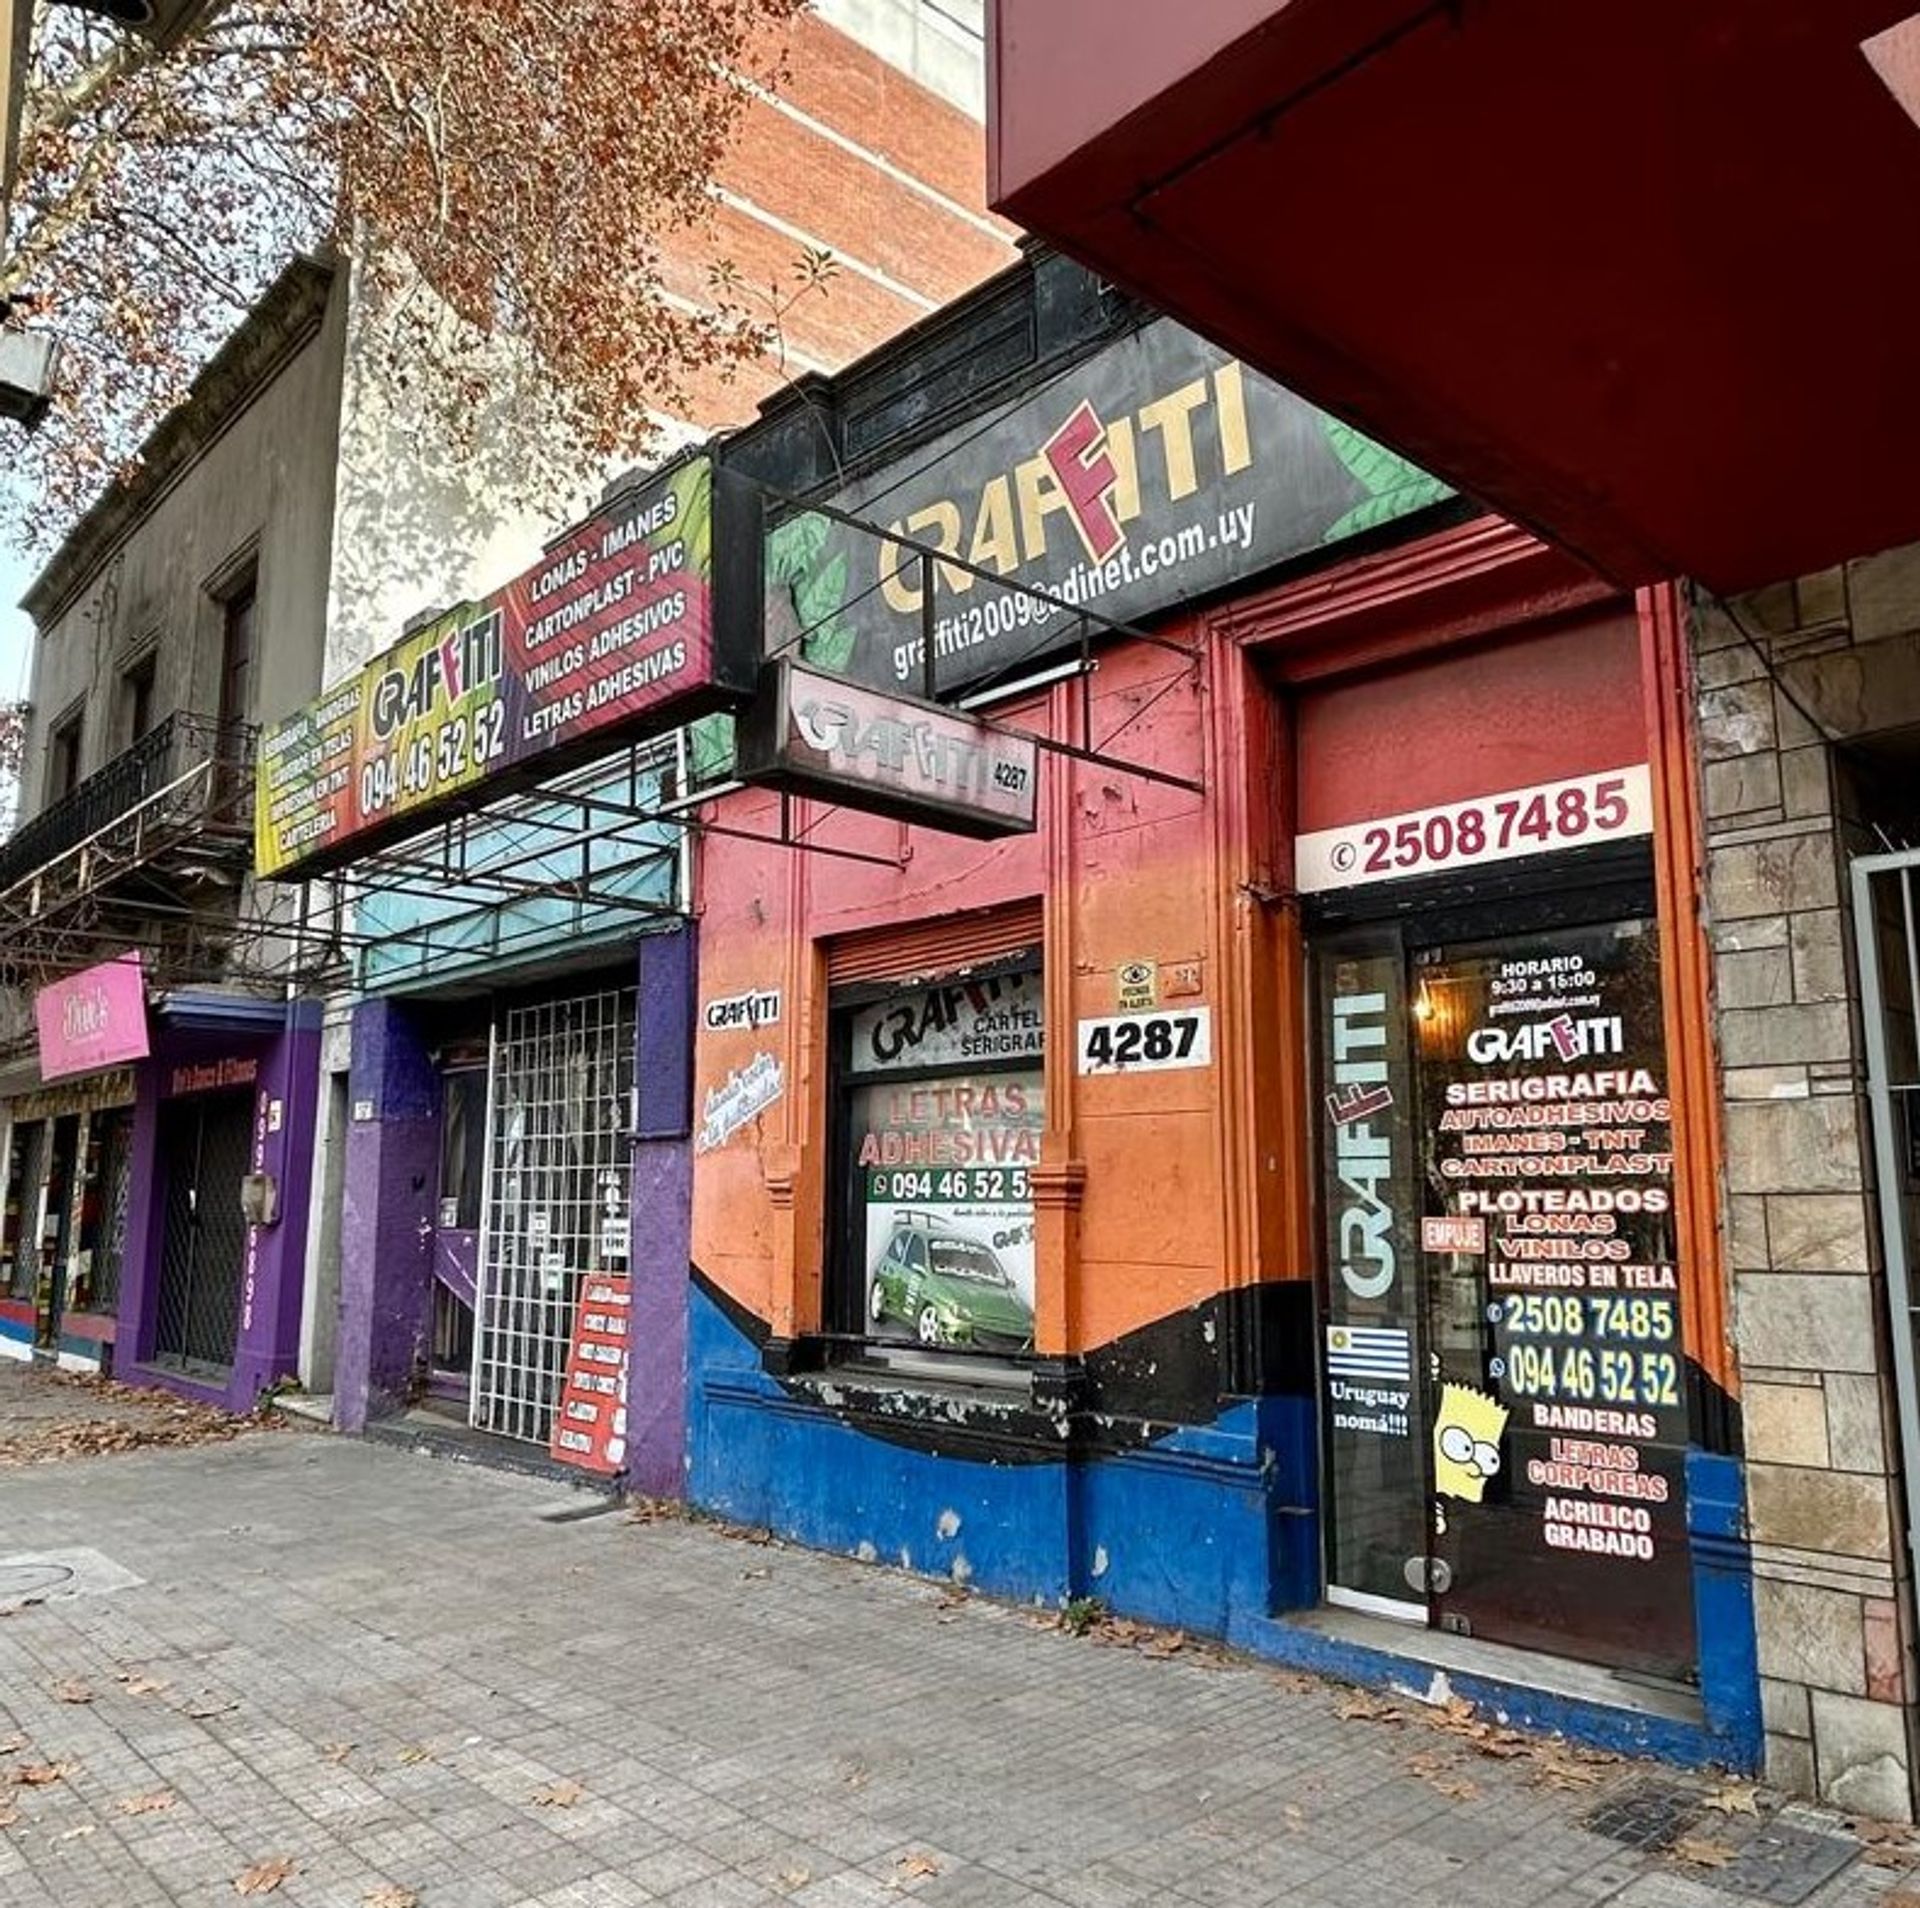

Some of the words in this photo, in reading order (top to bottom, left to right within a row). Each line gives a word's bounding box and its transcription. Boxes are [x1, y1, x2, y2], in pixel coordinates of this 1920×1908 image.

[878, 359, 1252, 613] GRAFFITI
[532, 549, 587, 601] LONAS
[602, 494, 676, 561] IMANES
[525, 568, 634, 650] CARTONPLAST
[648, 540, 684, 582] PVC
[525, 641, 584, 694] VINILOS
[589, 591, 686, 659] ADHESIVOS
[372, 608, 504, 742] GRAFFITI
[523, 690, 583, 739] LETRAS
[585, 641, 686, 719] ADHESIVAS
[361, 754, 399, 816] 094
[402, 739, 431, 795] 46
[437, 720, 467, 777] 52
[473, 699, 505, 762] 52
[993, 762, 1026, 791] 4287
[1363, 808, 1486, 873] 2508
[1495, 779, 1629, 848] 7485
[1502, 956, 1583, 977] HORARIO
[1086, 1017, 1199, 1066] 4287
[1467, 1012, 1623, 1064] GRAFFITI
[890, 1083, 1028, 1125] LETRAS
[1446, 1070, 1657, 1105] SERIGRAFIA
[1440, 1101, 1671, 1130] AUTOADHESIVOS
[859, 1127, 1040, 1166] ADHESIVA
[1326, 993, 1395, 1299] GRAFFITI
[1463, 1132, 1565, 1153] IMANES
[1583, 1129, 1646, 1150] TNT
[1441, 1155, 1673, 1177] CARTONPLAST
[893, 1172, 932, 1199] 094
[938, 1171, 967, 1199] 46
[974, 1171, 1004, 1199] 52
[1012, 1170, 1033, 1198] 5
[1460, 1189, 1668, 1213] PLOTEADOS
[1426, 1221, 1481, 1248] EMPUJE
[1507, 1213, 1616, 1235] LONAS
[1497, 1238, 1630, 1261] VINILOS
[1490, 1262, 1584, 1287] LLAVEROS
[1590, 1264, 1617, 1287] EN
[1621, 1265, 1676, 1290] TELA
[1507, 1295, 1582, 1335] 2508
[1591, 1299, 1672, 1340] 7485
[1510, 1345, 1555, 1396] 094
[1562, 1348, 1594, 1399] 46
[1601, 1351, 1635, 1402] 52
[1642, 1353, 1678, 1406] 52
[1330, 1381, 1409, 1407] Uruguay
[1534, 1404, 1656, 1438] BANDERAS
[1551, 1439, 1638, 1471] LETRAS
[1544, 1525, 1654, 1560] GRABADO
